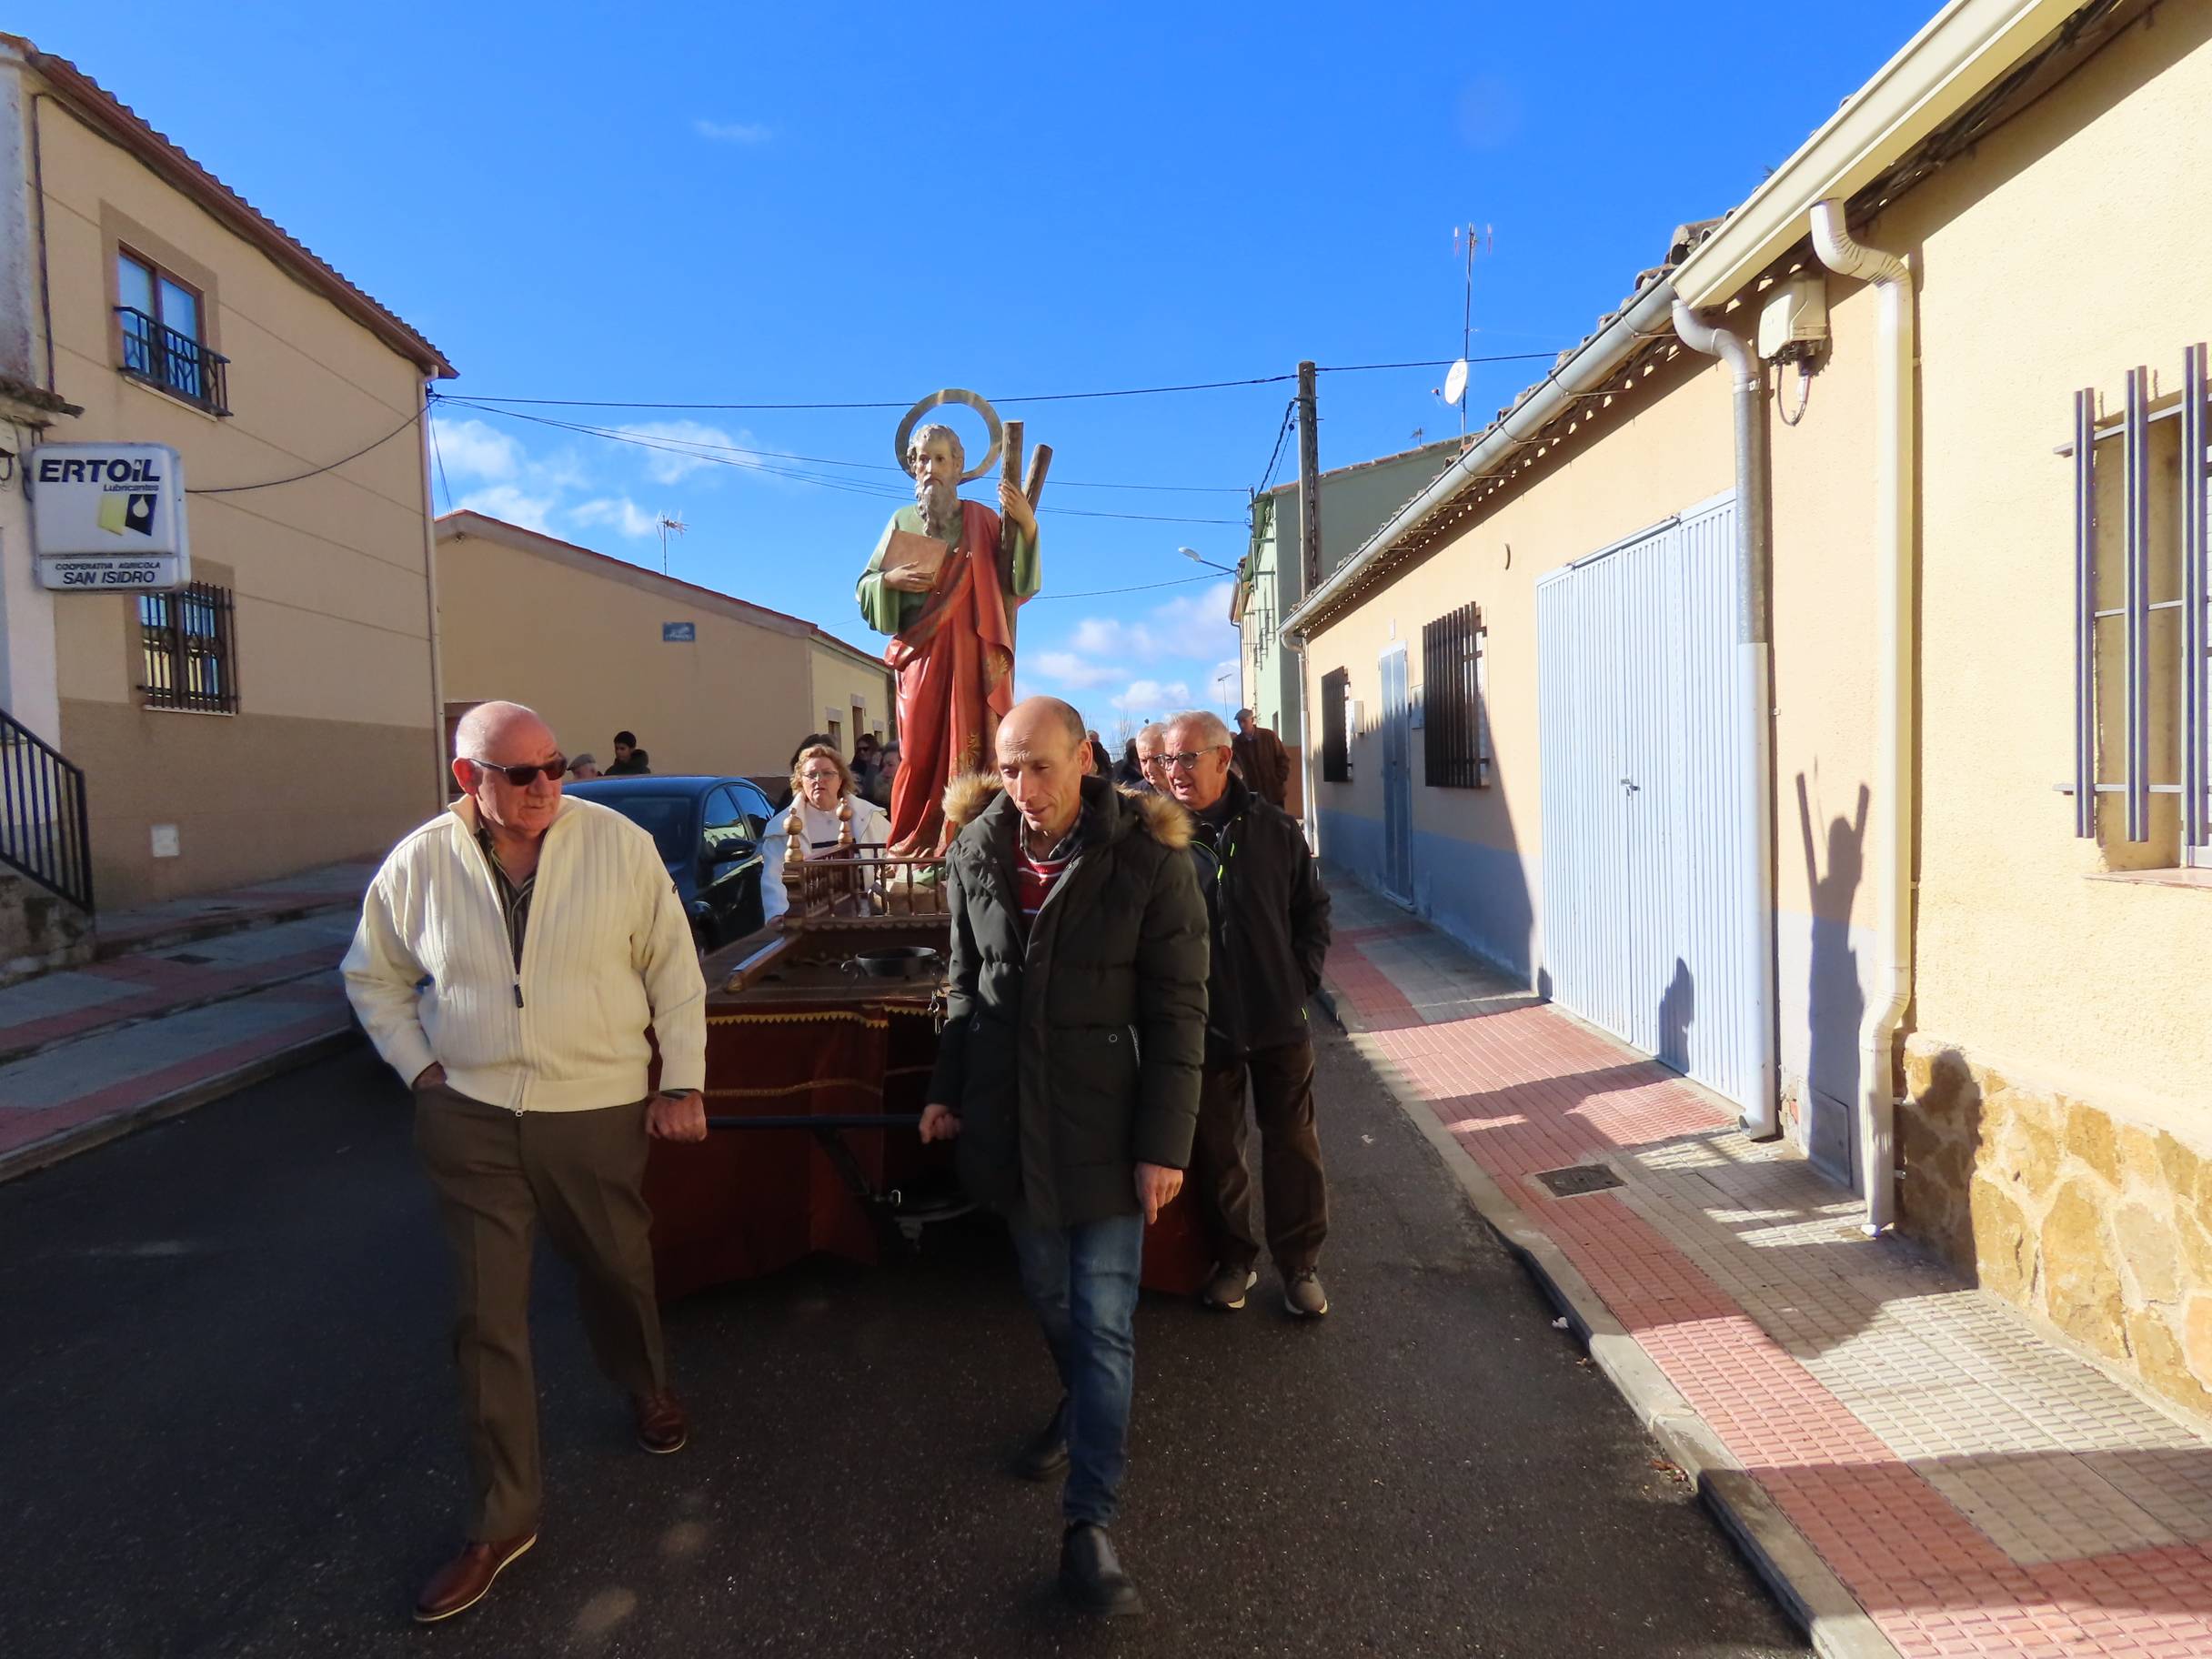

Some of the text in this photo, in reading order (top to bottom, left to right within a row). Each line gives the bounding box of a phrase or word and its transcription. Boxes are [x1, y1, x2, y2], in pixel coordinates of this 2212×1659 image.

[39, 458, 160, 483] ERTOiL
[104, 484, 159, 492] Lubricantes
[55, 561, 160, 570] COOPERATIVA AGRICOLA
[63, 570, 155, 585] SAN ISIDRO
